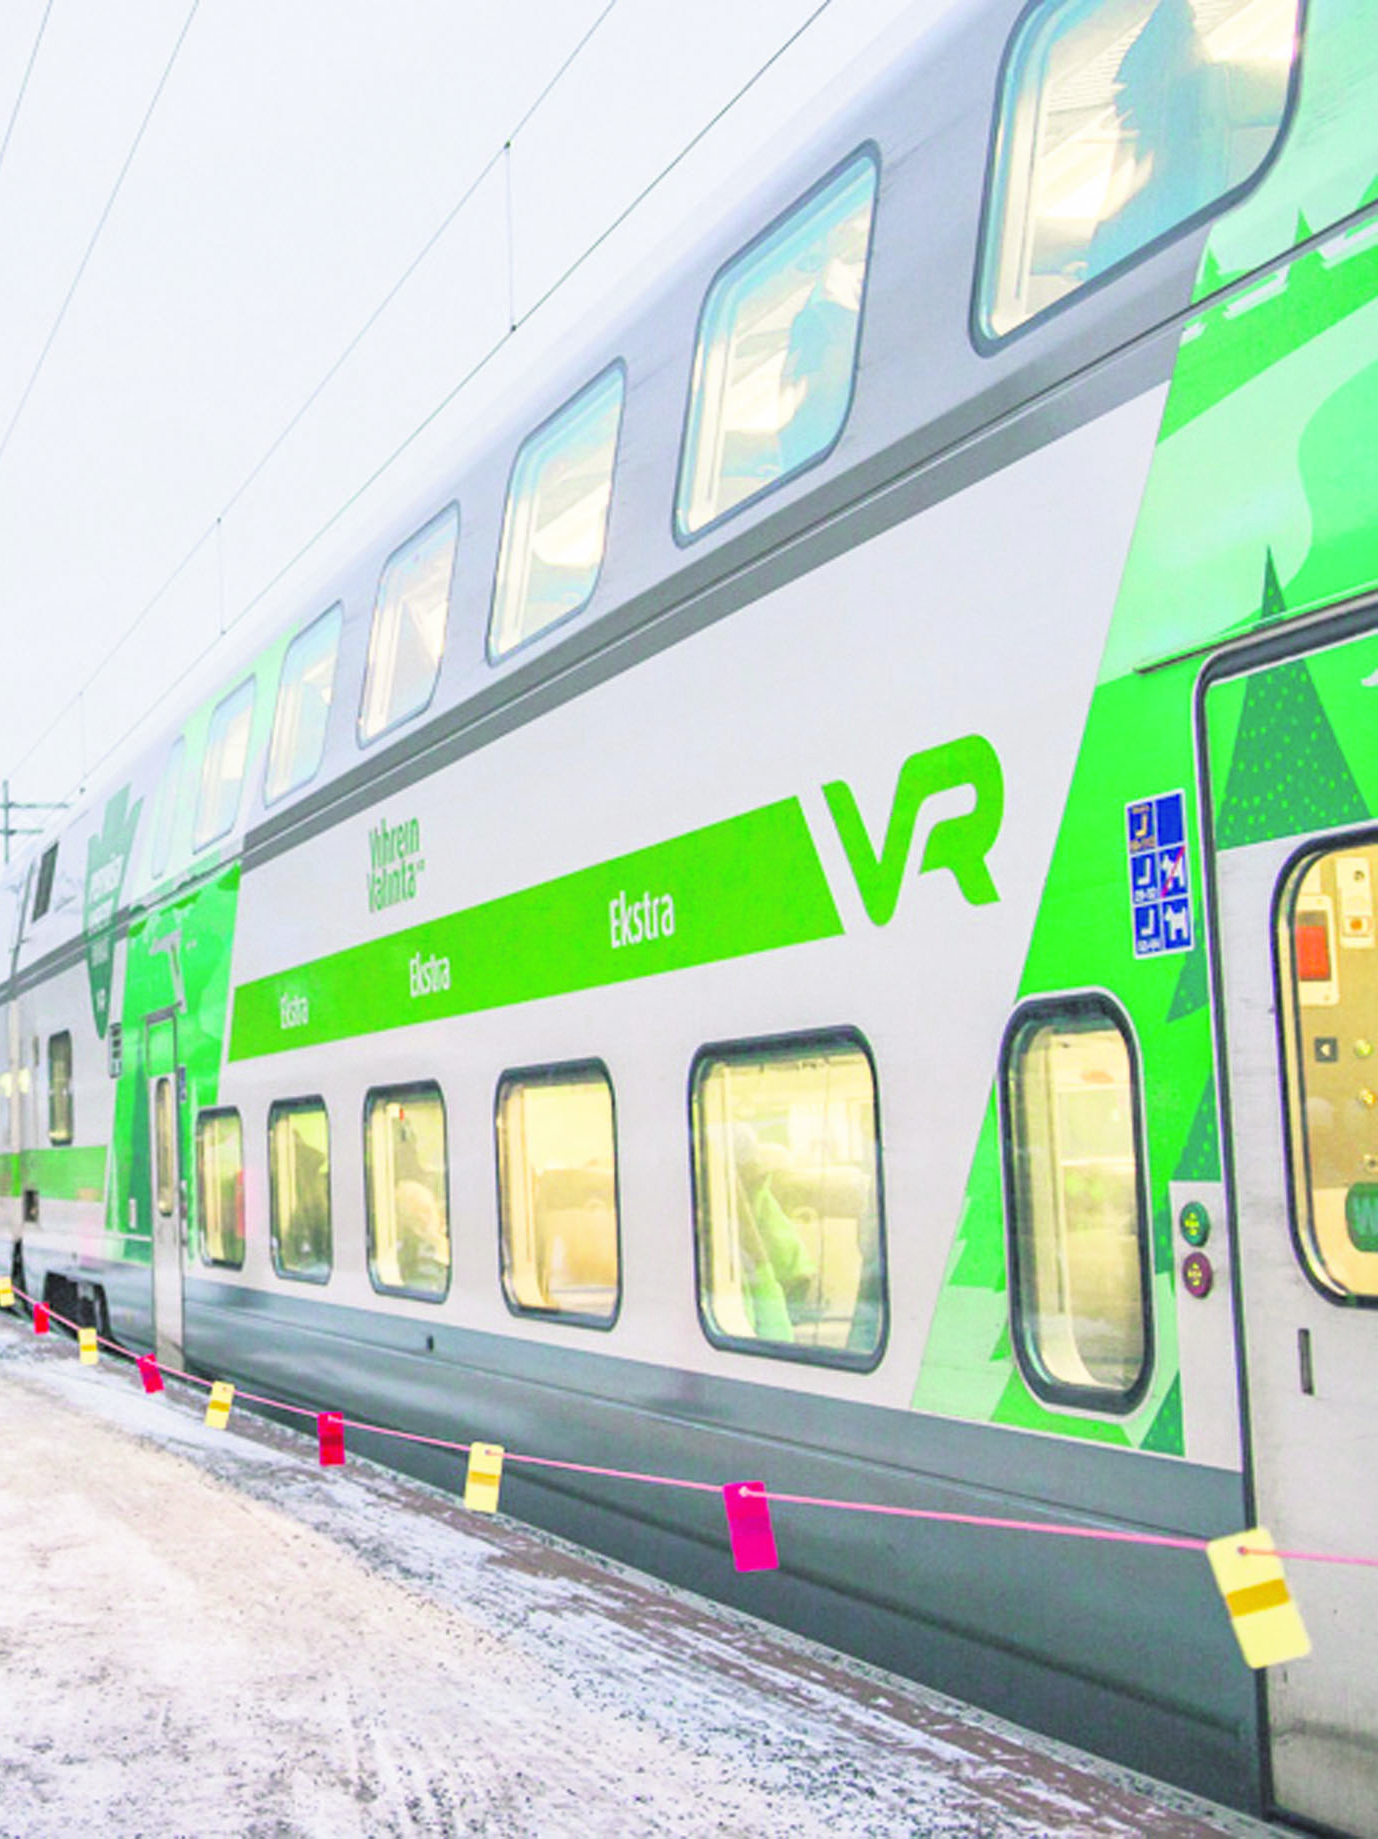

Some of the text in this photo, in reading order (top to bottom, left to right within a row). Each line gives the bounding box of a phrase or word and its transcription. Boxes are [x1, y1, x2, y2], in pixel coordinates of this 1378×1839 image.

[821, 733, 1005, 928] VR
[279, 889, 675, 1031] Ekstra Ekstra Ekstra
